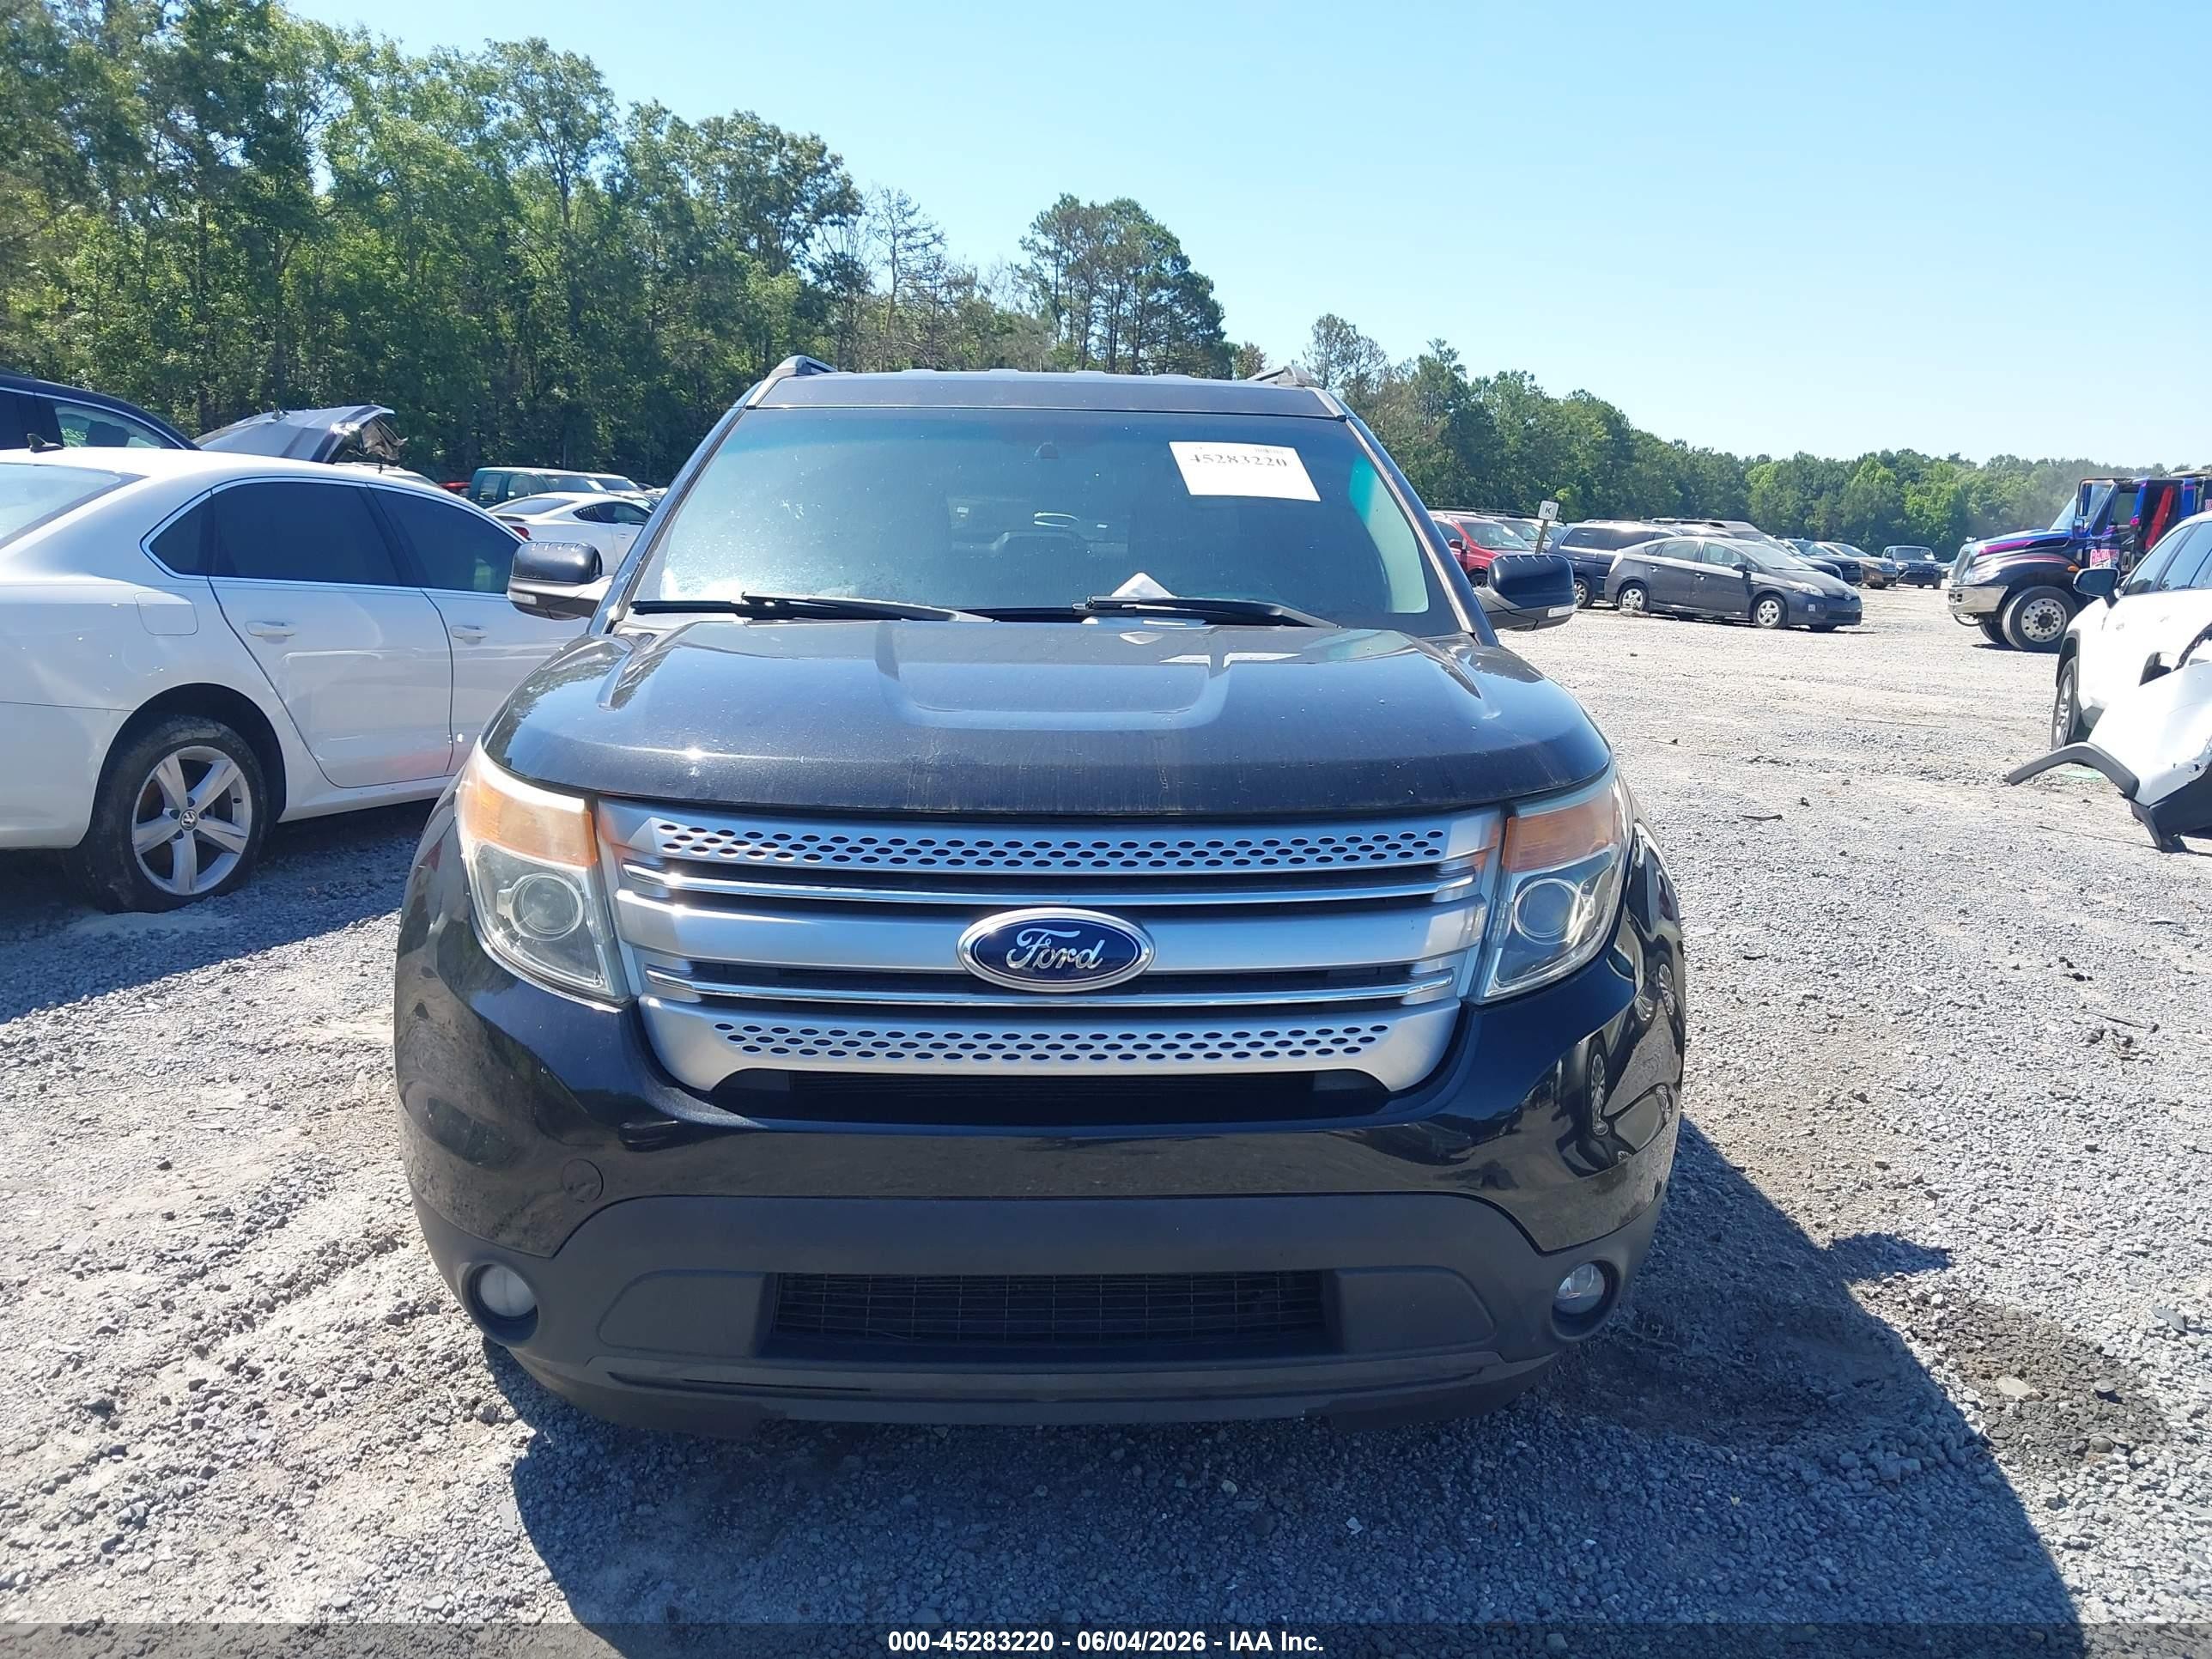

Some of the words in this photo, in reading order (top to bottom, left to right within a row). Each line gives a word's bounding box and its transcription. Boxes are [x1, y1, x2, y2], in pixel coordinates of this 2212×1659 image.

[1190, 453, 1288, 467] 45283220
[1545, 506, 1553, 515] K
[1006, 927, 1106, 970] Ford
